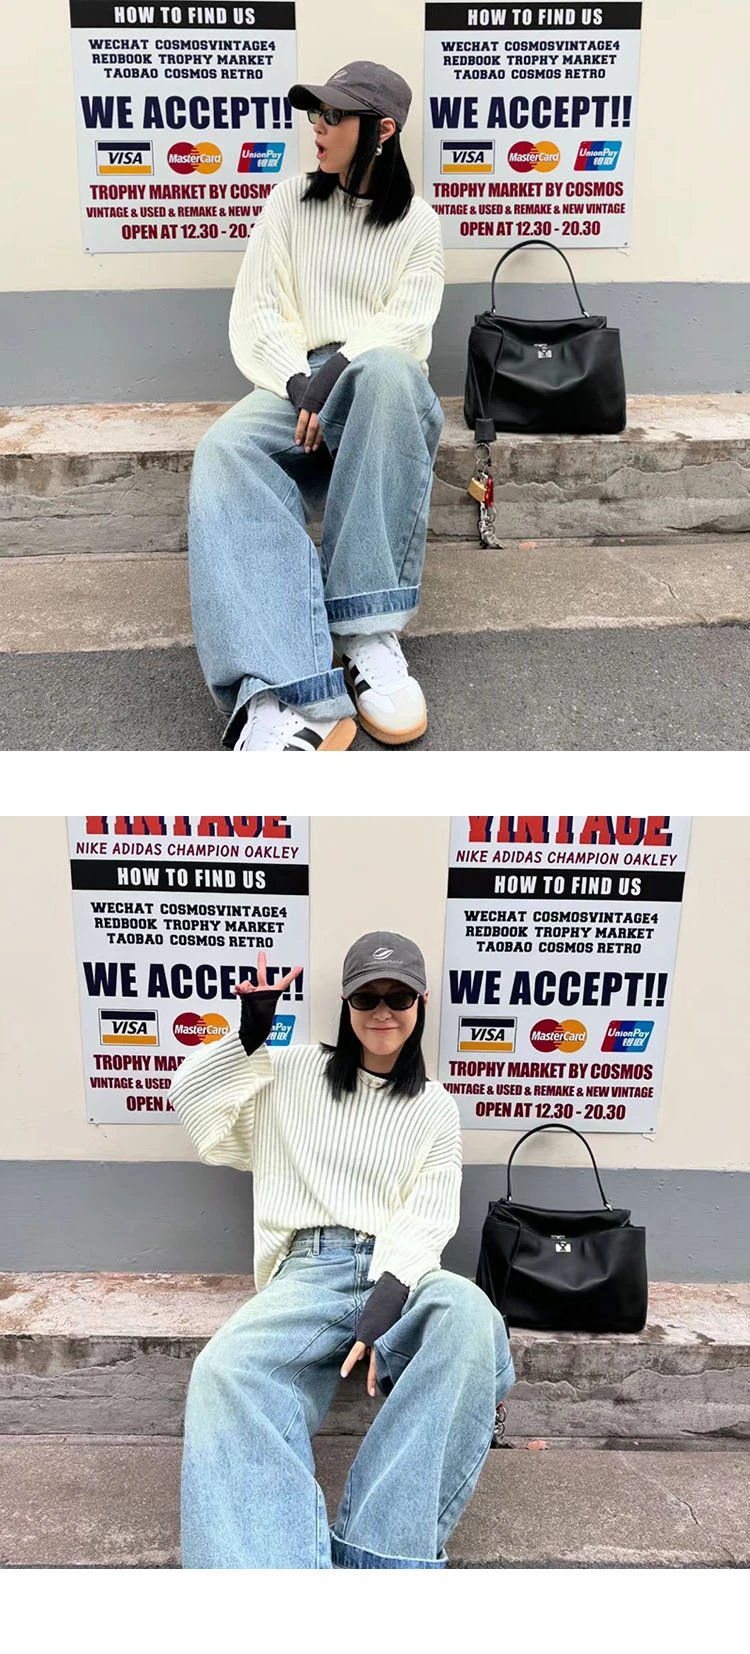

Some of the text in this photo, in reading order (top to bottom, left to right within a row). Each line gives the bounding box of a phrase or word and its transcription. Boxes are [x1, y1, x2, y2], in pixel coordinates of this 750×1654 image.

[114, 7, 255, 24] HOW TO FIND US
[468, 8, 603, 25] HOW TO FIND US
[89, 40, 276, 50] WECHAT COSMOSVINTAGE4
[441, 40, 620, 51] WECHAT COSMOSVINTAGE4
[92, 54, 273, 65] REDBOOK TROPHY MARKET
[444, 55, 616, 65] REDBOOK TROPHY MARKET
[104, 69, 263, 79] TAOBAO COSMOS RETRO
[454, 69, 605, 79] TAOBAO COSMOS RETRO
[81, 96, 292, 129] WE ACCEPT!!
[430, 96, 632, 129] WE ACCEPT!!
[108, 152, 142, 164] VISA
[169, 154, 221, 164] MasterCard
[242, 150, 282, 160] UnionPay
[452, 151, 484, 163] VISA
[509, 153, 559, 162] MasterCard
[579, 148, 618, 158] UnionPay
[90, 184, 278, 200] TROPHY MARKET BY COSM
[433, 182, 623, 197] TROPHY MARKET BY COSMOS
[86, 207, 128, 218] VINTAGE
[131, 209, 137, 217] &
[141, 206, 165, 218] USED
[169, 208, 175, 217] &
[178, 206, 216, 217] REMAKE
[220, 208, 226, 217] &
[229, 206, 250, 216] NEW
[470, 206, 477, 215] &
[479, 204, 503, 215] USED
[505, 206, 512, 214] &
[514, 204, 552, 214] REMAKE
[554, 205, 560, 214] &
[563, 204, 584, 214] NEW
[586, 203, 625, 214] VINTAGE
[122, 225, 157, 239] OPEN
[161, 224, 178, 239] AT
[181, 224, 218, 239] 12.30
[230, 223, 258, 238] 20.
[460, 222, 493, 236] OPEN
[496, 222, 513, 236] AT
[516, 221, 551, 236] 12.30
[562, 221, 600, 235] 20.30
[76, 842, 299, 859] NIKE ADIDAS CHAMPION OAKLEY
[456, 851, 677, 866] NIKE ADIDAS CHAMPION OAKLEY
[117, 867, 266, 889] HOW TO FIND US
[494, 876, 642, 895] HOW TO FIND US
[90, 902, 287, 918] WECHAT COSMOSVINTAGE4
[464, 911, 658, 924] WECHAT COSMOSVINTAGE4
[95, 918, 284, 933] REDBOOK TROPHY MARKET
[466, 926, 654, 939] REDBOOK TROPHY MARKET
[107, 933, 273, 948] TAOBAO COSMOS RETRO
[477, 941, 641, 954] TAOBAO COSMOS RETRO
[83, 962, 138, 997] WE
[449, 970, 668, 1007] WE ACCEPT!!
[112, 1021, 147, 1034] VISA
[175, 1024, 229, 1035] MasterCard
[608, 1028, 649, 1039] UnionPay
[470, 1028, 505, 1041] VISA
[532, 1031, 585, 1041] MasterCard
[93, 1054, 151, 1070] TROPHY
[449, 1061, 653, 1079] TROPHY MARKET BY COSMOS
[90, 1077, 171, 1089] VINTAGE & USED
[443, 1083, 653, 1098] VINTAGE & USED & REMAKE & NEW VINTAGE
[127, 1096, 175, 1111] OPEN A
[476, 1102, 511, 1117] OPEN
[514, 1103, 532, 1118] AT
[535, 1104, 573, 1119] 12.30
[584, 1104, 625, 1119] 20.30
